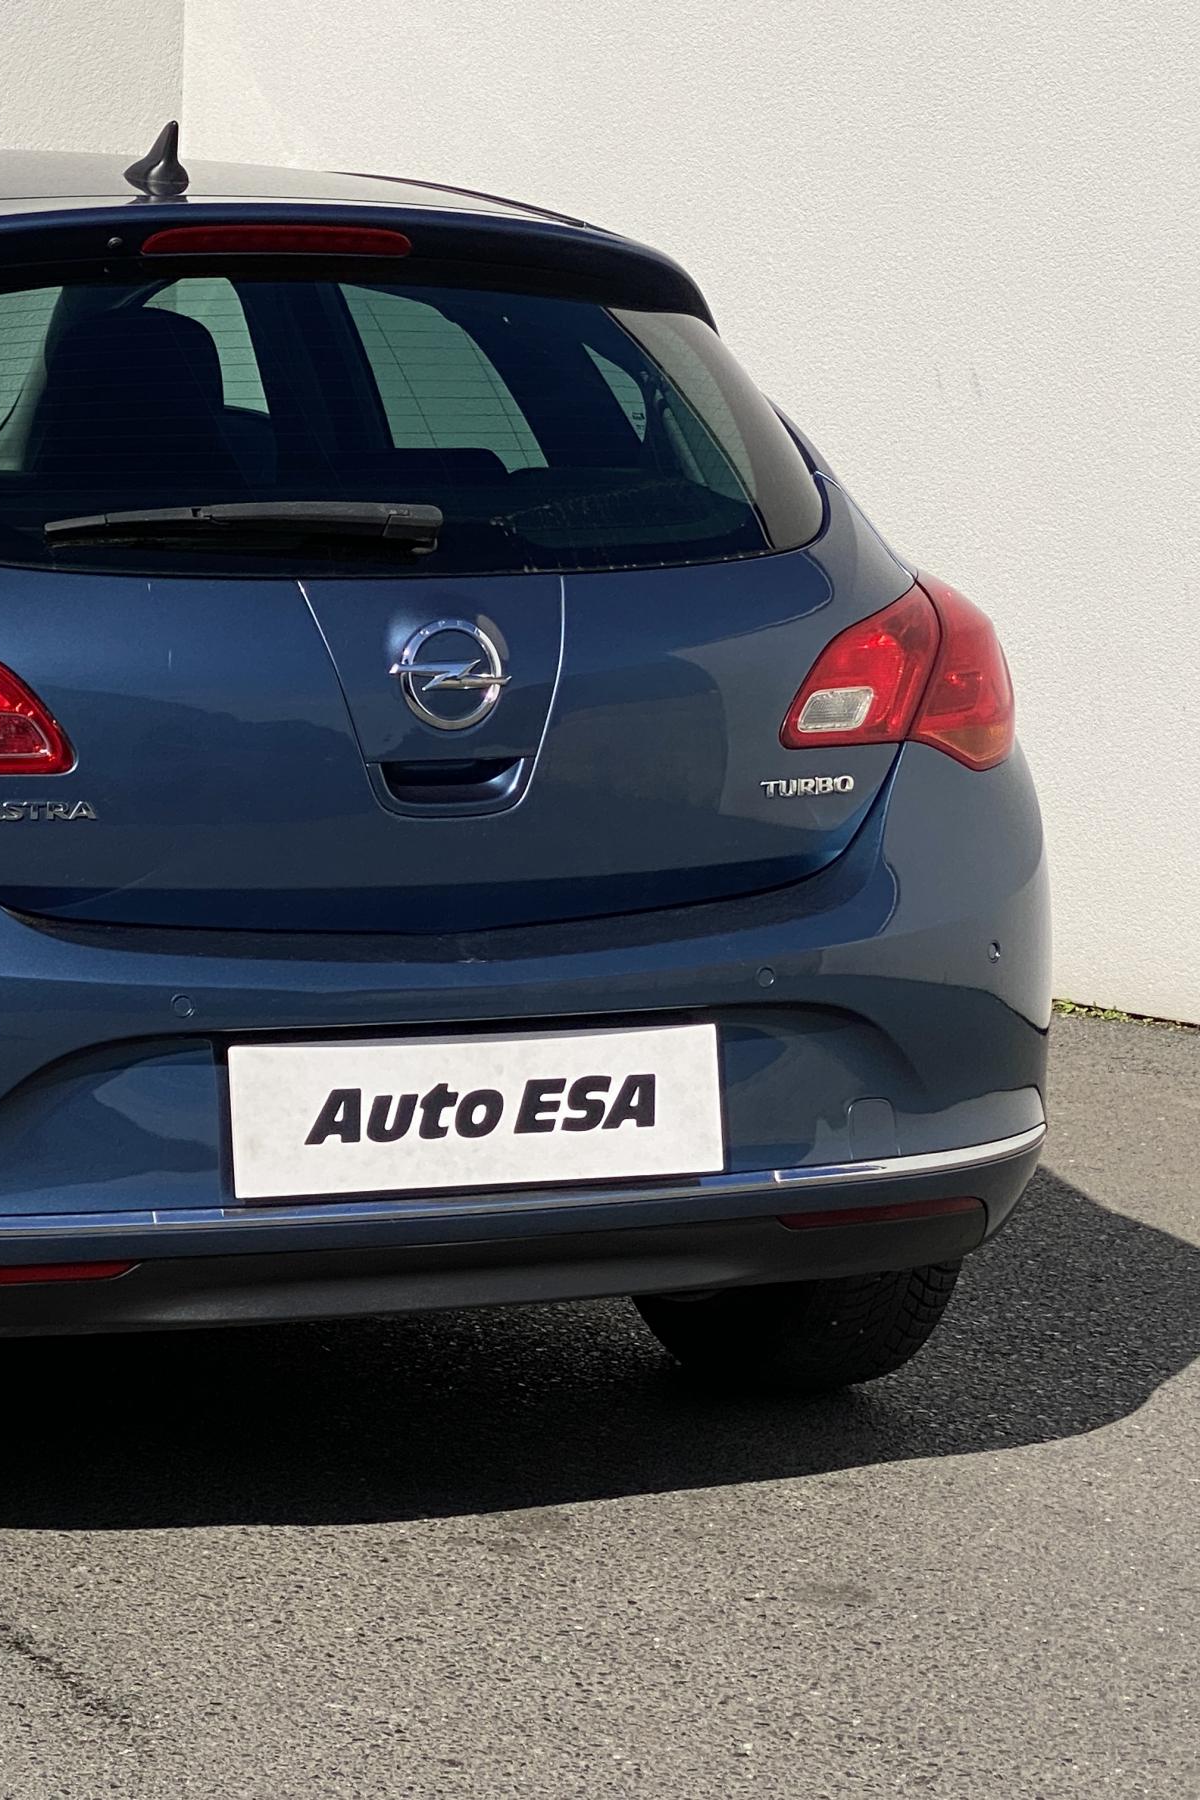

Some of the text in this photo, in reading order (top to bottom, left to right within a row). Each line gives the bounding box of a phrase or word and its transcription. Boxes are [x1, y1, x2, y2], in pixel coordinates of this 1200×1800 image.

[760, 775, 855, 799] TURBO
[303, 1073, 656, 1145] Auto ESA
